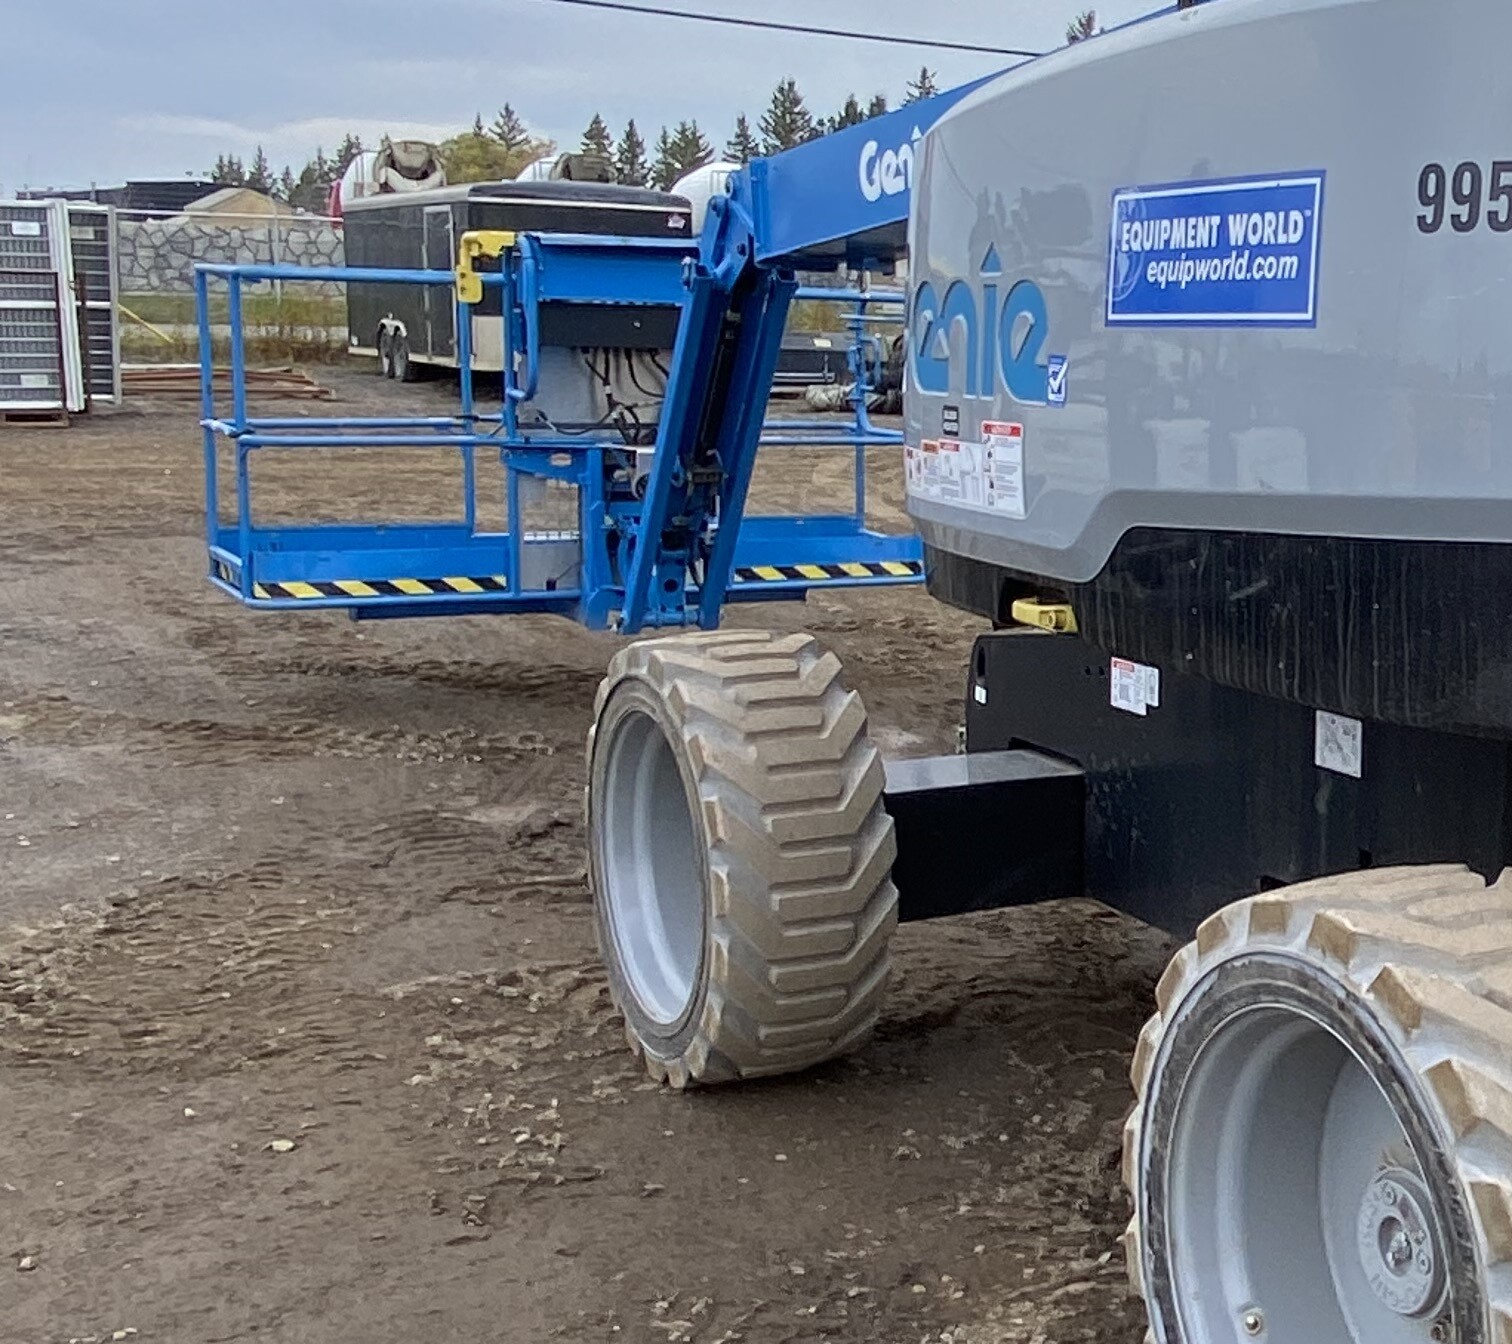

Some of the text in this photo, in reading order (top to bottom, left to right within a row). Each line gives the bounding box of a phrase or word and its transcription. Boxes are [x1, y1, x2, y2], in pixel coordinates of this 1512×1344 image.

[859, 124, 922, 203] Gen
[1120, 209, 1304, 253] EQUIPMENT WORLD
[1146, 249, 1299, 290] equipworld.com
[913, 241, 1048, 406] enie
